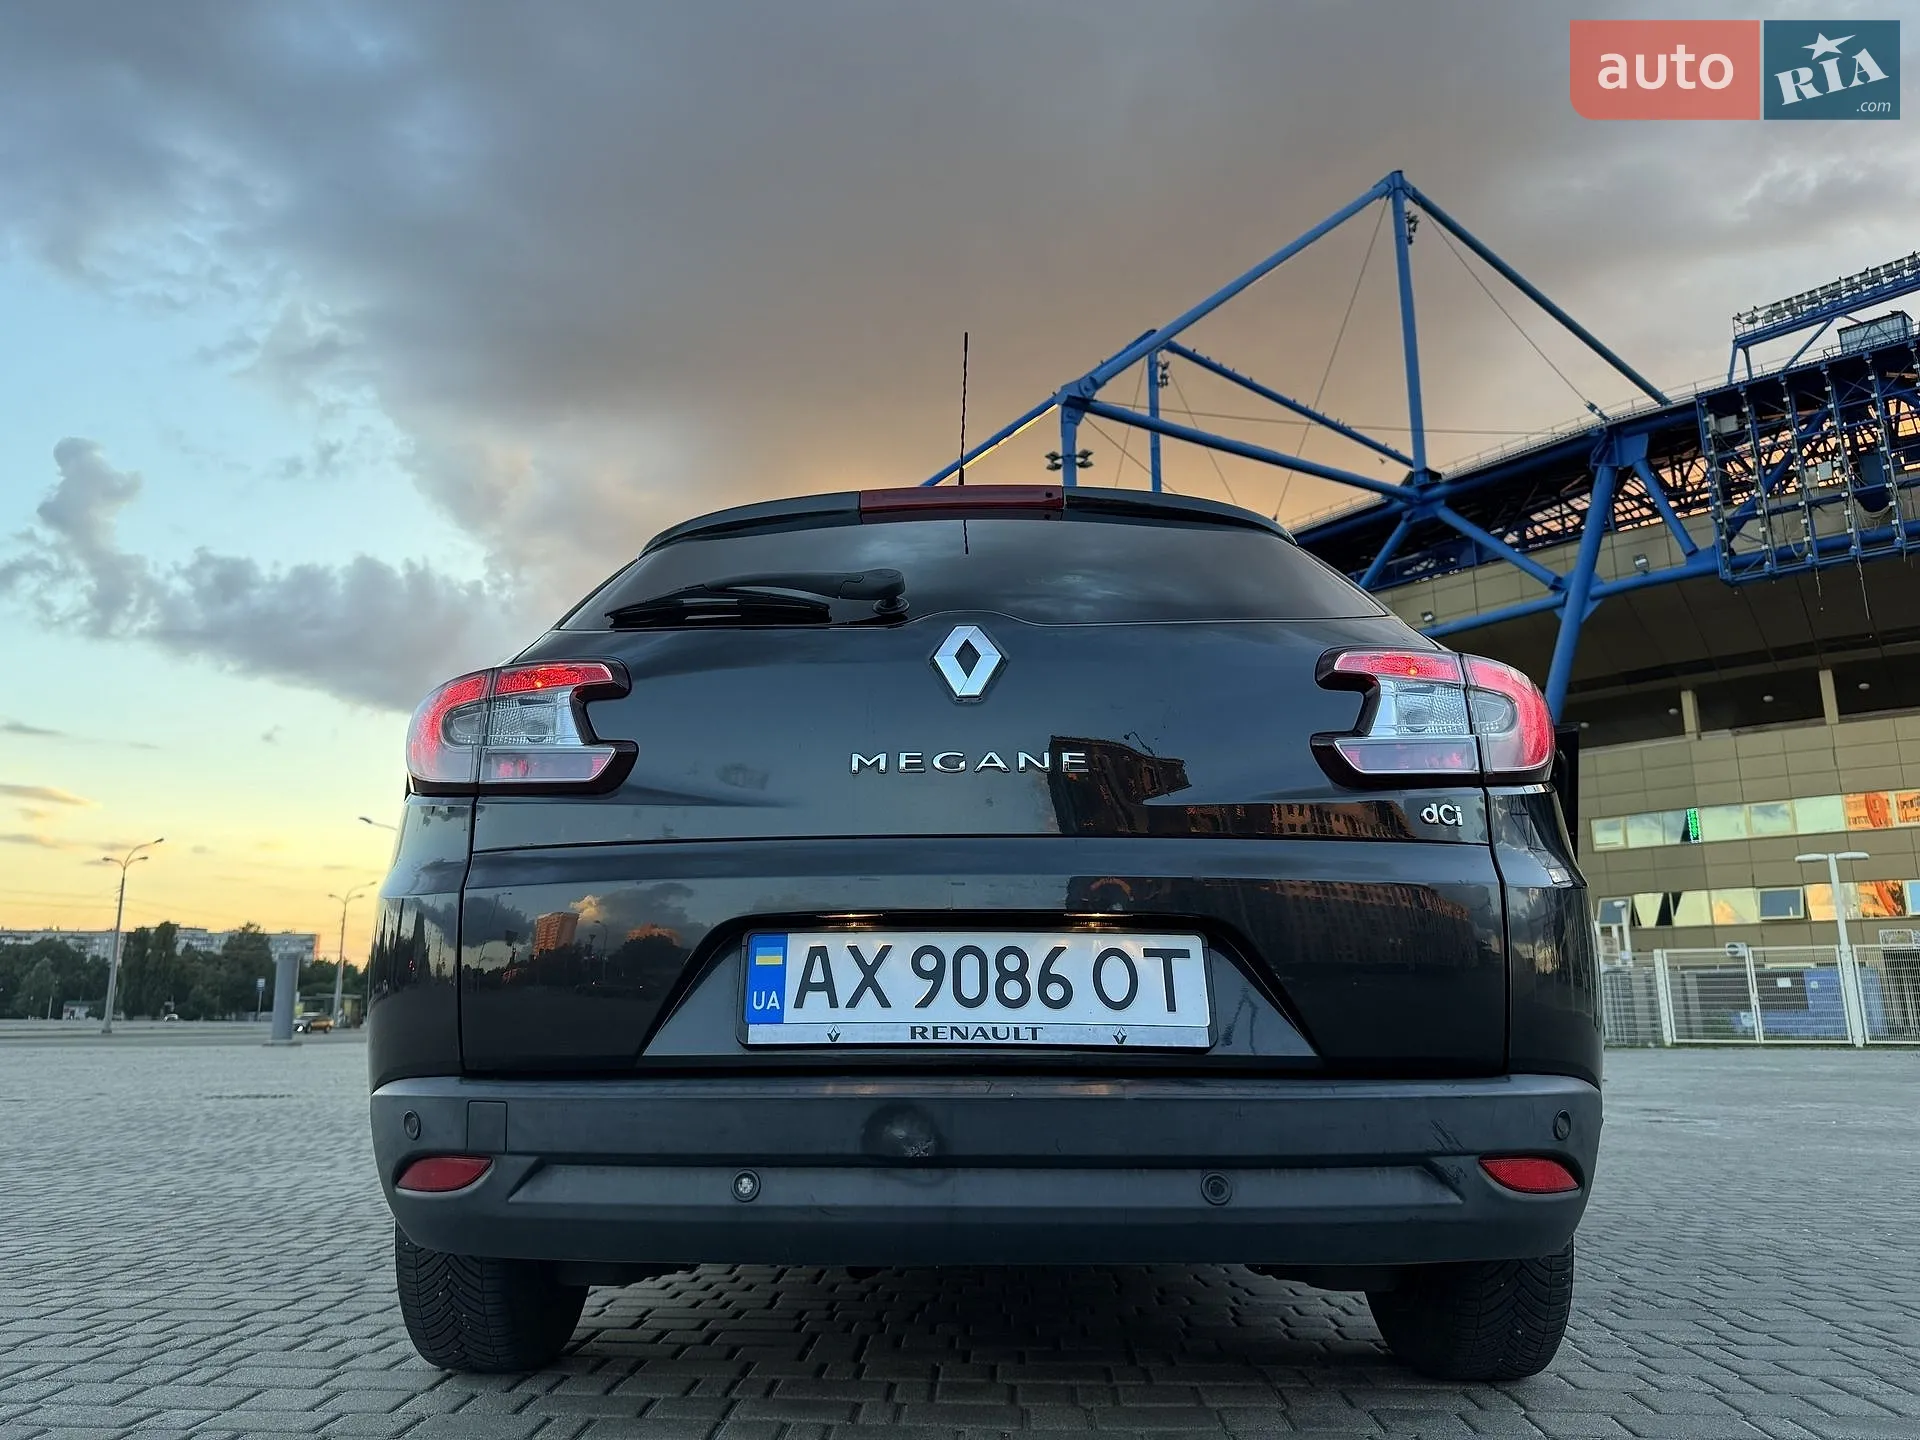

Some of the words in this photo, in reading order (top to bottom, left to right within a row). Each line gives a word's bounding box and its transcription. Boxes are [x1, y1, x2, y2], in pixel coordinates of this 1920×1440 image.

[850, 751, 1090, 774] MEGANE
[1420, 803, 1463, 826] dCi
[793, 945, 893, 1009] AX
[910, 944, 1074, 1010] 9086
[1092, 947, 1191, 1012] OT
[752, 991, 781, 1011] UA
[909, 1025, 1044, 1042] RENAULT
